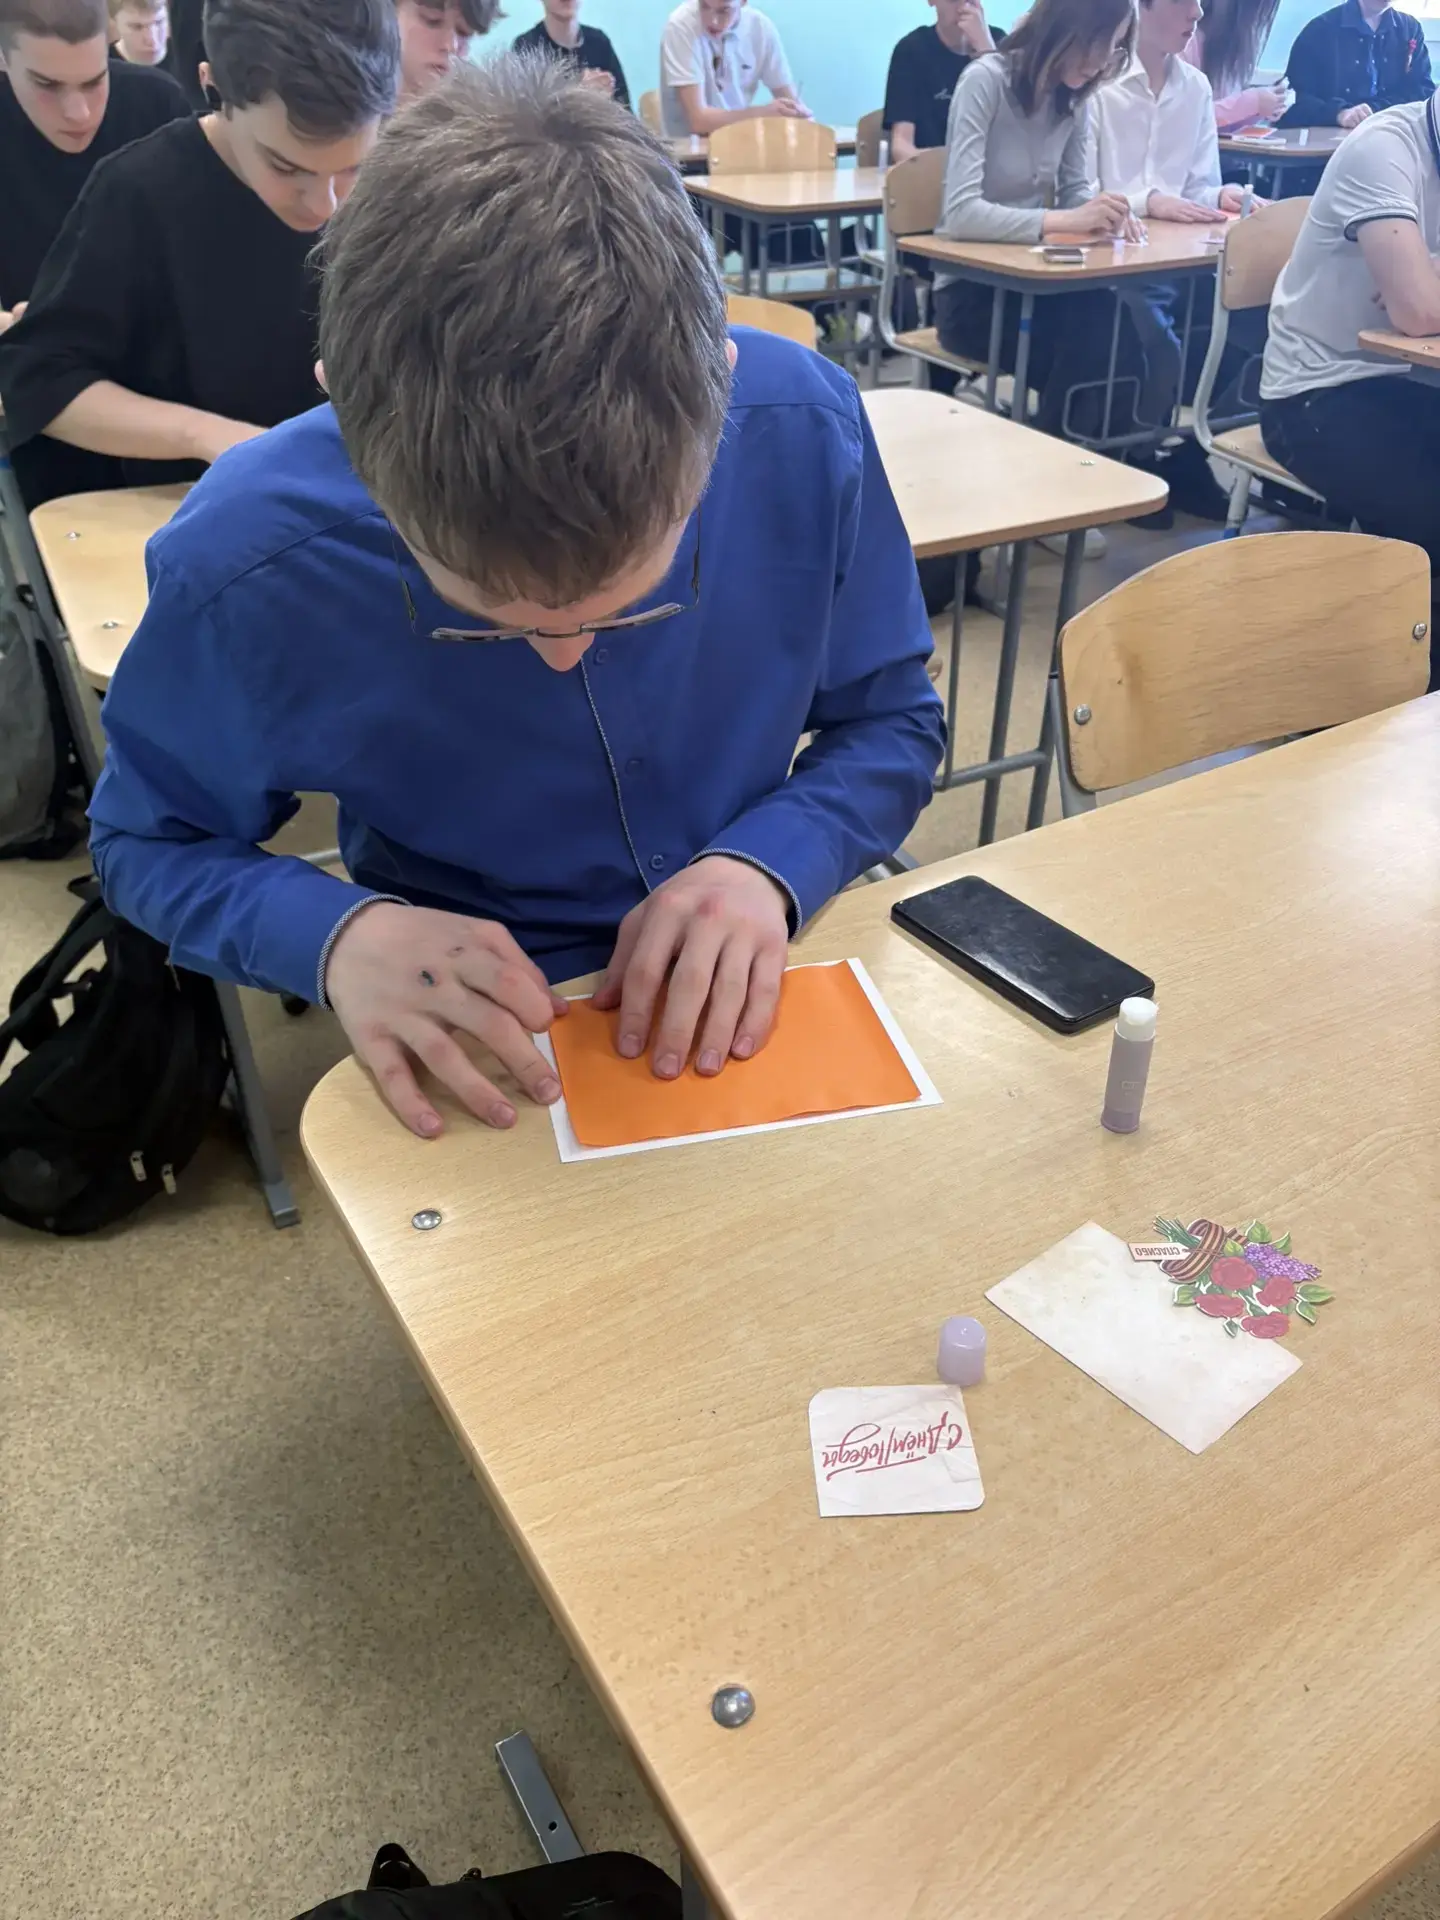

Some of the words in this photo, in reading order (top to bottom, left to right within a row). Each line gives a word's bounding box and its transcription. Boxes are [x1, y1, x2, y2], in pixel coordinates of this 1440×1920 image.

[1134, 1246, 1181, 1257] СПАСИБО
[822, 1423, 896, 1482] Победы
[894, 1411, 948, 1459] Днём
[948, 1423, 963, 1450] С
